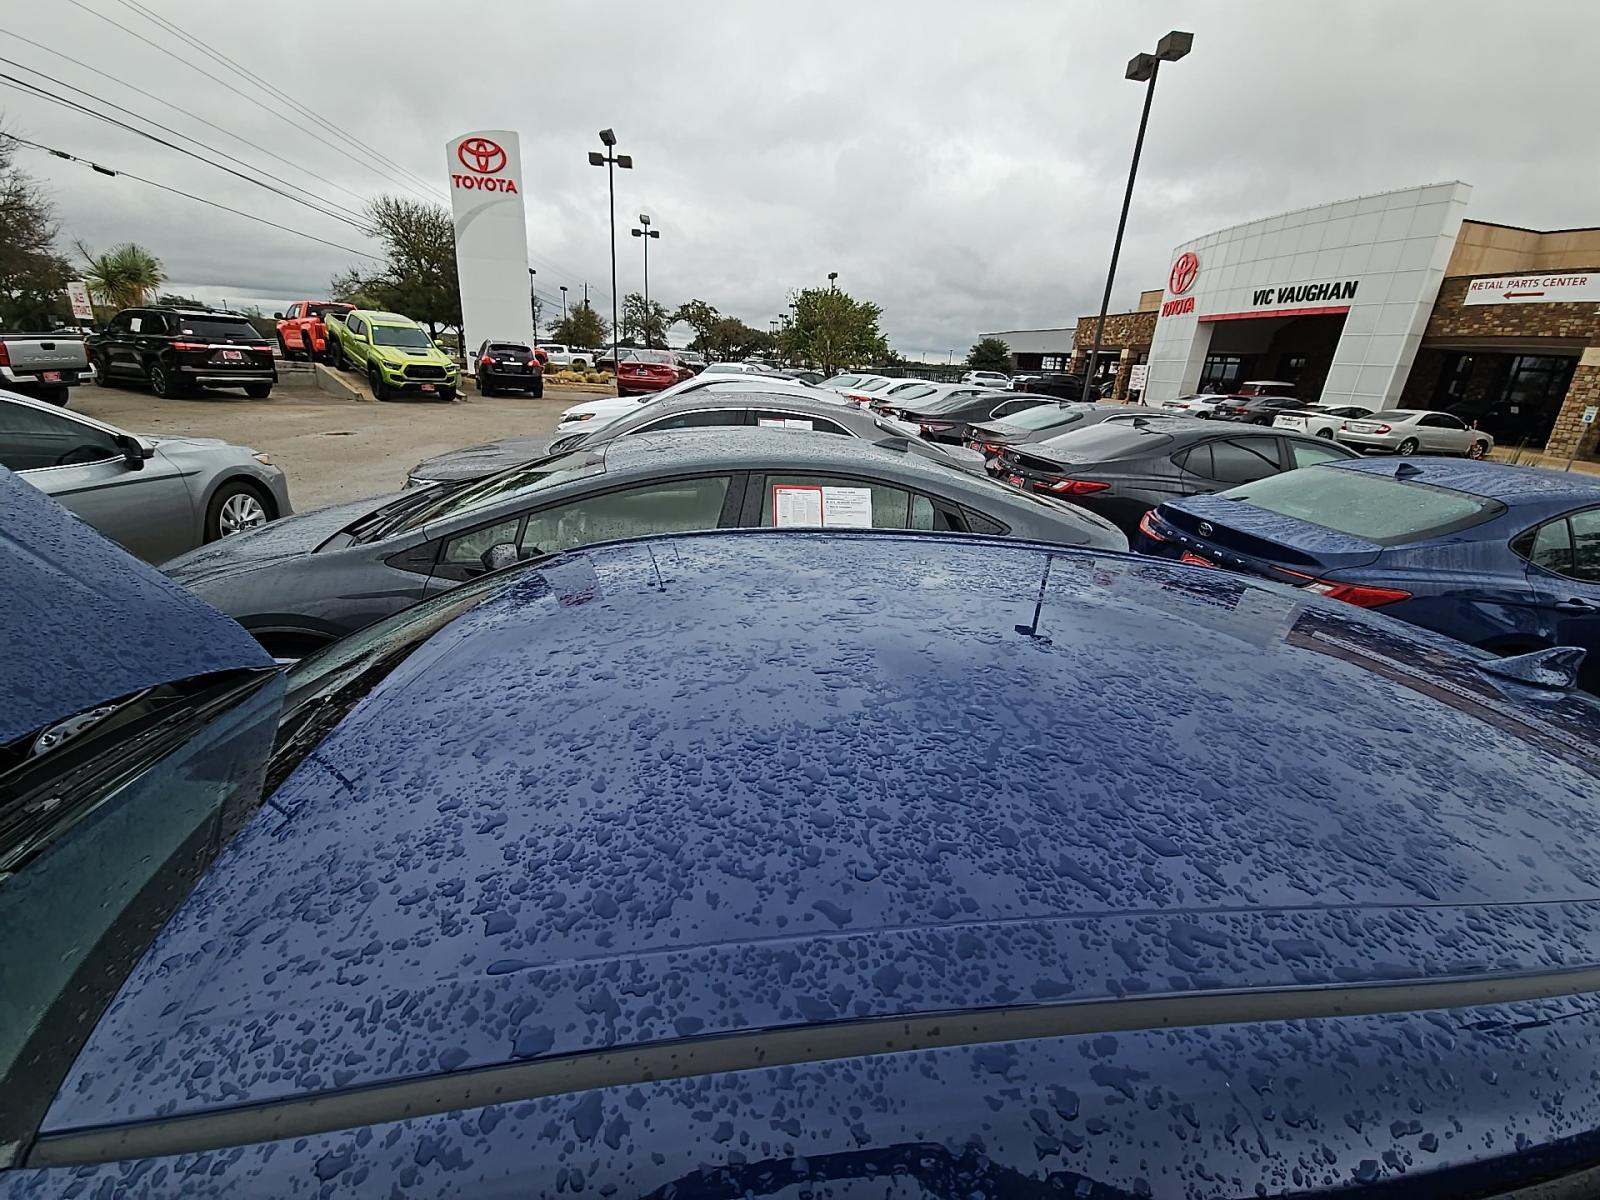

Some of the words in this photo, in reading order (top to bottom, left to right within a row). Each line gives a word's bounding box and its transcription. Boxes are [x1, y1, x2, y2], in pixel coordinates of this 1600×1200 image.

[452, 174, 518, 194] TOYOTA
[1253, 288, 1275, 306] VIC
[1277, 280, 1359, 304] VAUGHAN
[1470, 281, 1505, 291] RETAIL
[1506, 279, 1540, 289] PARTS
[1542, 277, 1588, 287] CENTER
[1162, 297, 1195, 317] TOYOTA
